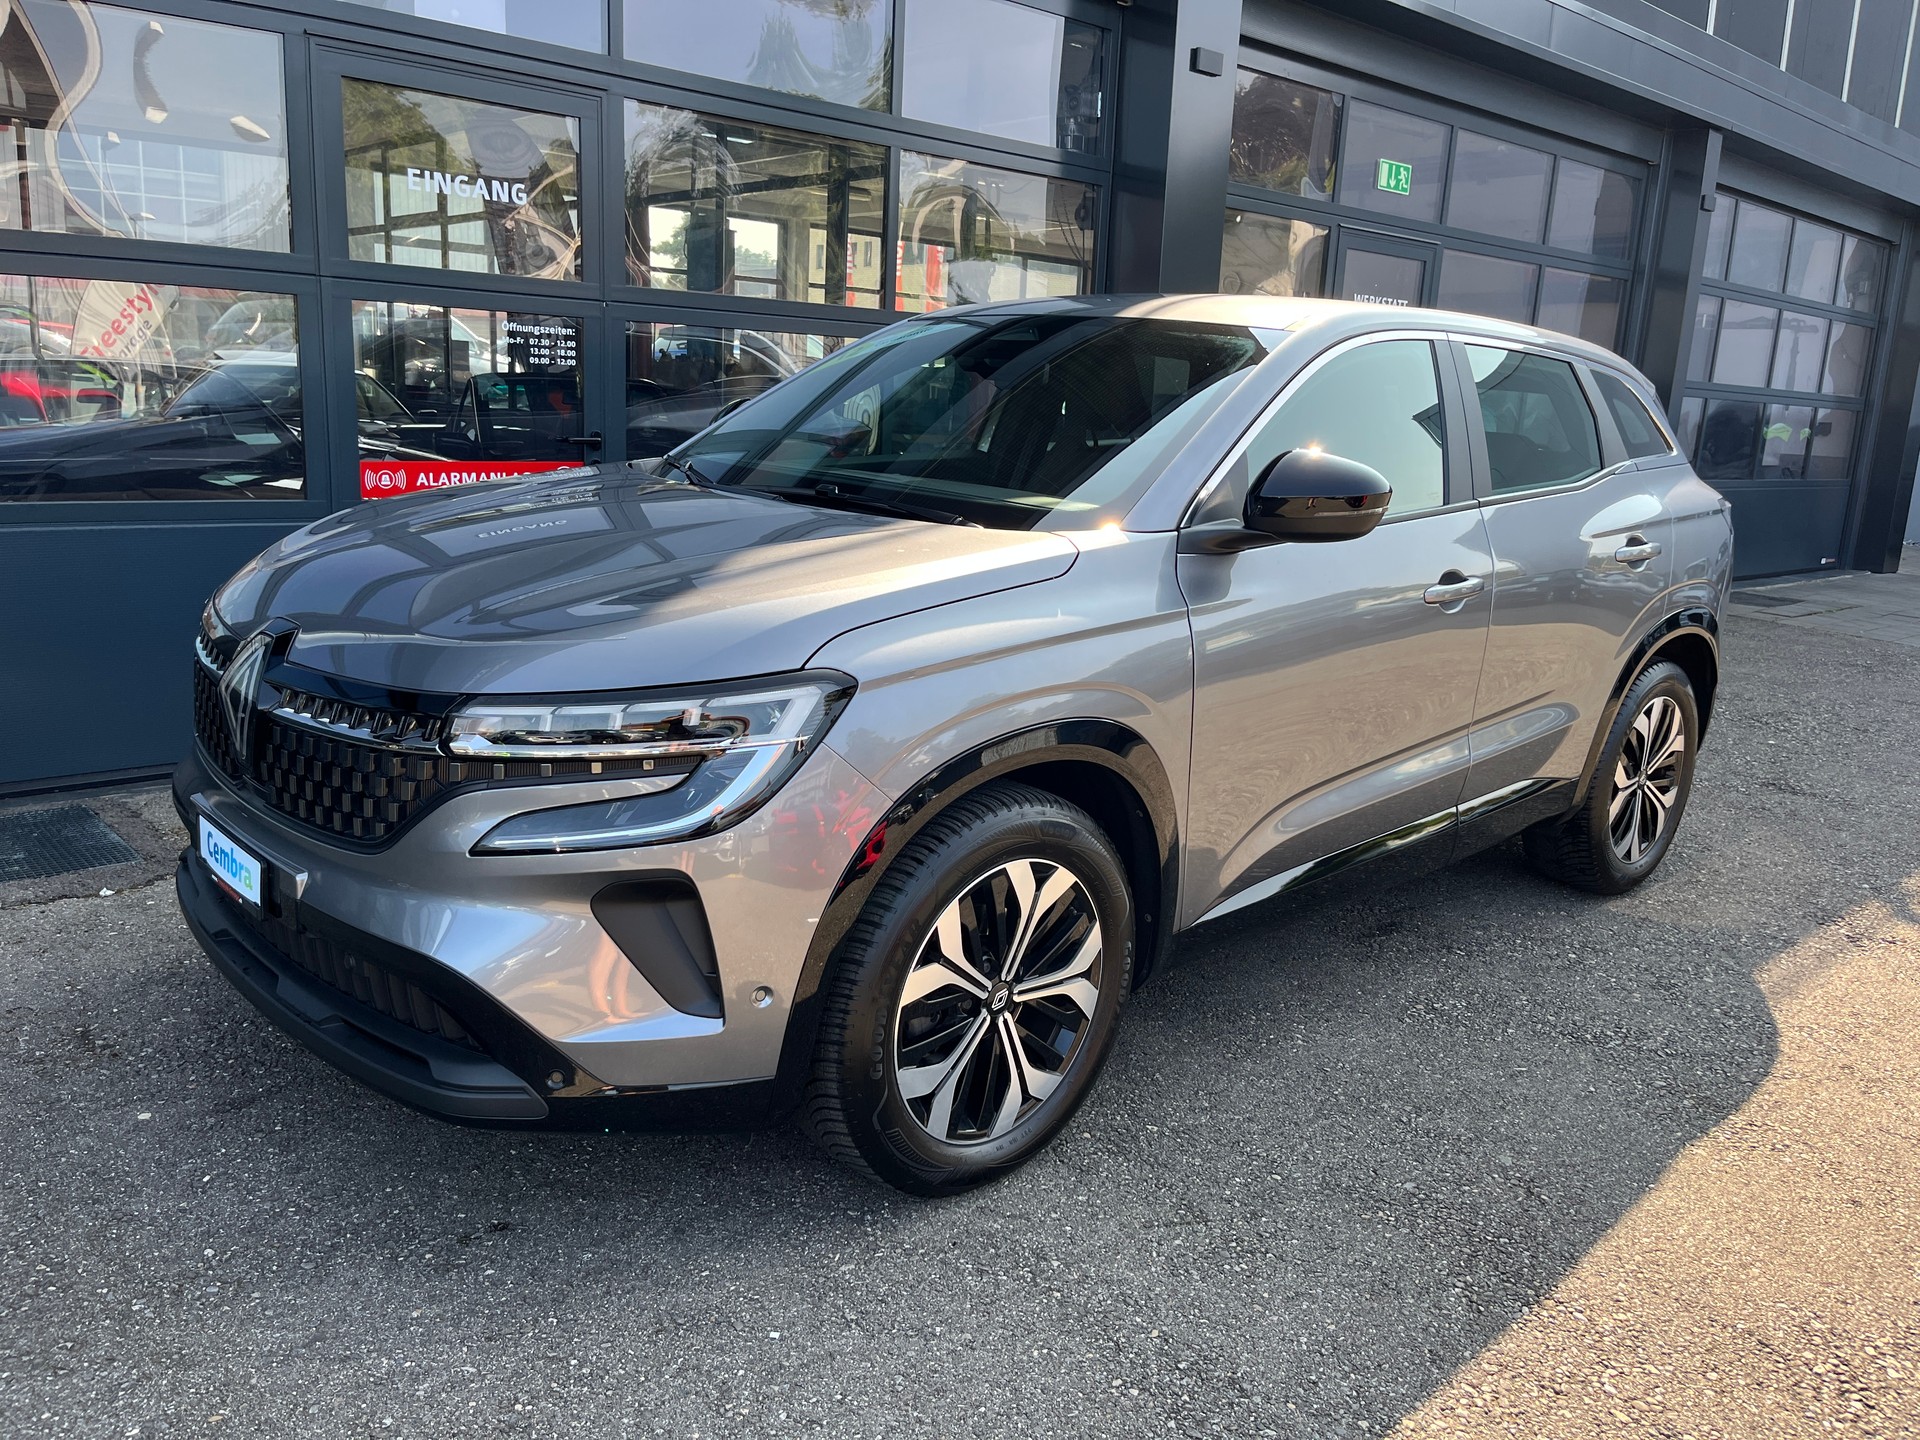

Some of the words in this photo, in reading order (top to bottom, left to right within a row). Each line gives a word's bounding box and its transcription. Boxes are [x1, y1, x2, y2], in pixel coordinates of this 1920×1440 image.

[407, 168, 528, 206] EINGANG
[80, 283, 165, 357] reestyl
[502, 321, 576, 336] Öffnungszeiten:
[114, 319, 153, 358] arage
[529, 338, 550, 346] 07.30
[557, 340, 577, 348] 12.00
[529, 347, 550, 356] 13.00
[557, 349, 577, 357] 18.00
[529, 356, 550, 365] 09.00
[557, 358, 577, 366] 12.00
[416, 472, 531, 487] ALARMAN
[207, 830, 253, 891] Cembra
